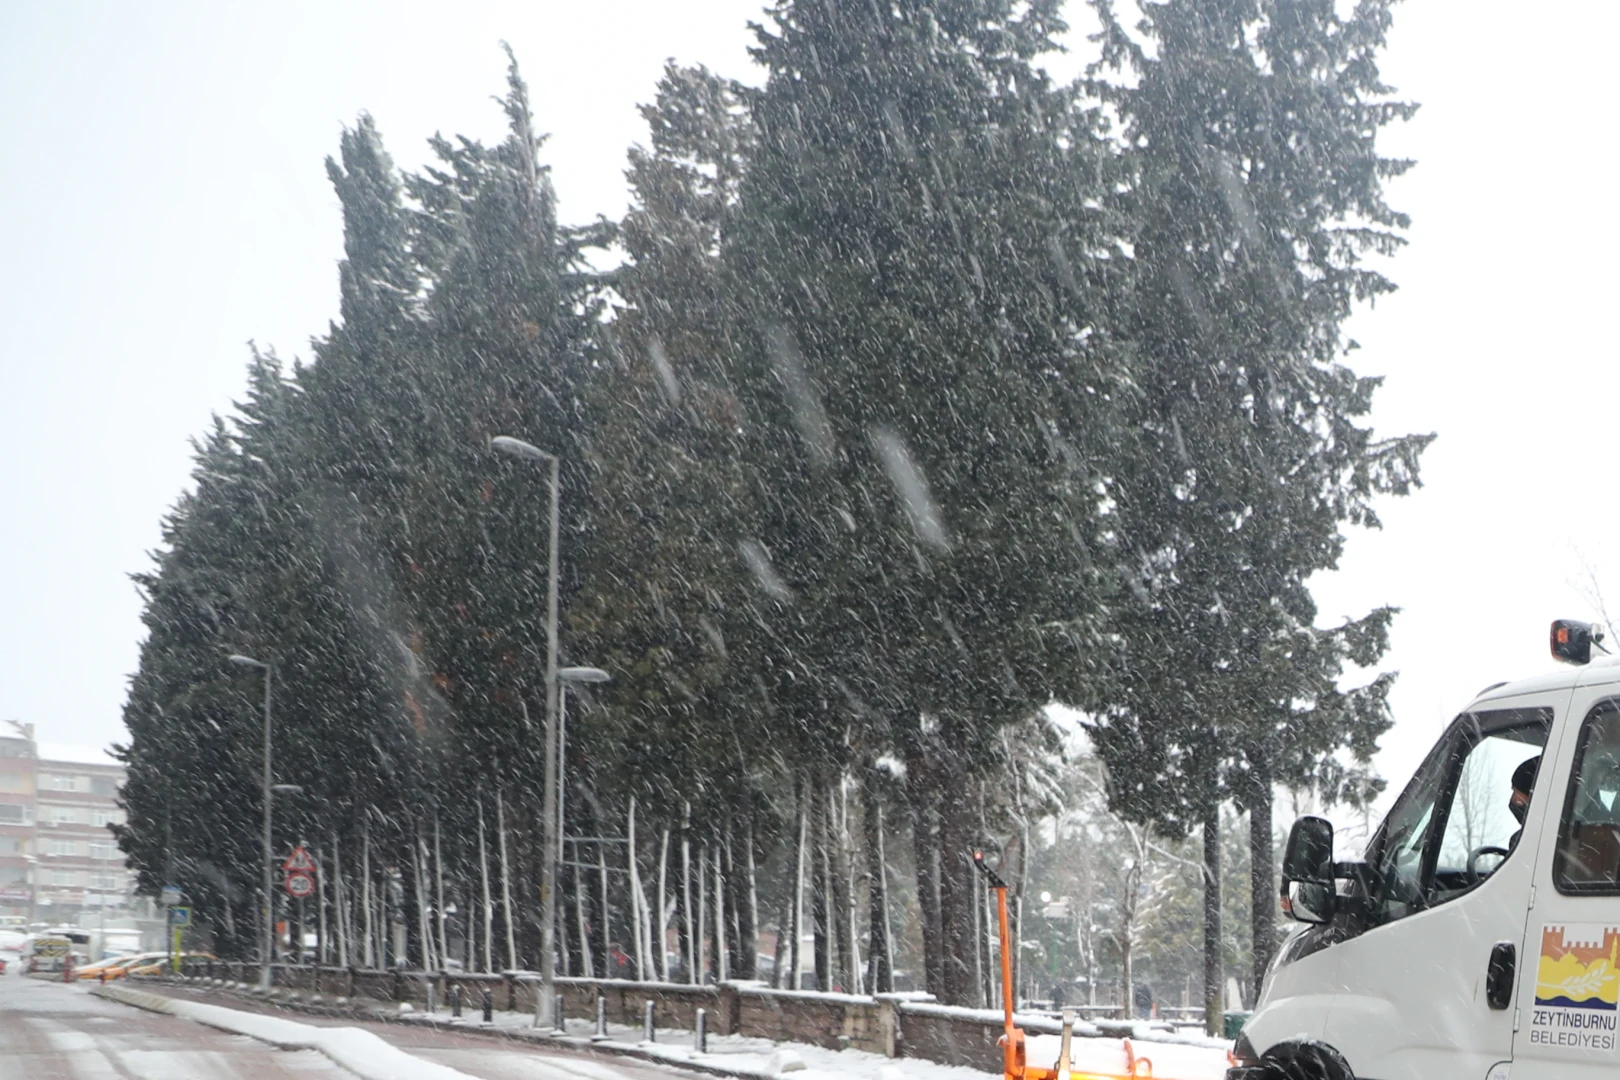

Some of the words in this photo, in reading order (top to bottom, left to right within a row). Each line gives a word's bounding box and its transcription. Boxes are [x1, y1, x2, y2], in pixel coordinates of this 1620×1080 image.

[292, 879, 308, 890] 20
[1532, 1008, 1617, 1031] ZEYTİNBURNU
[1530, 1030, 1615, 1050] BELEDİYESİ
